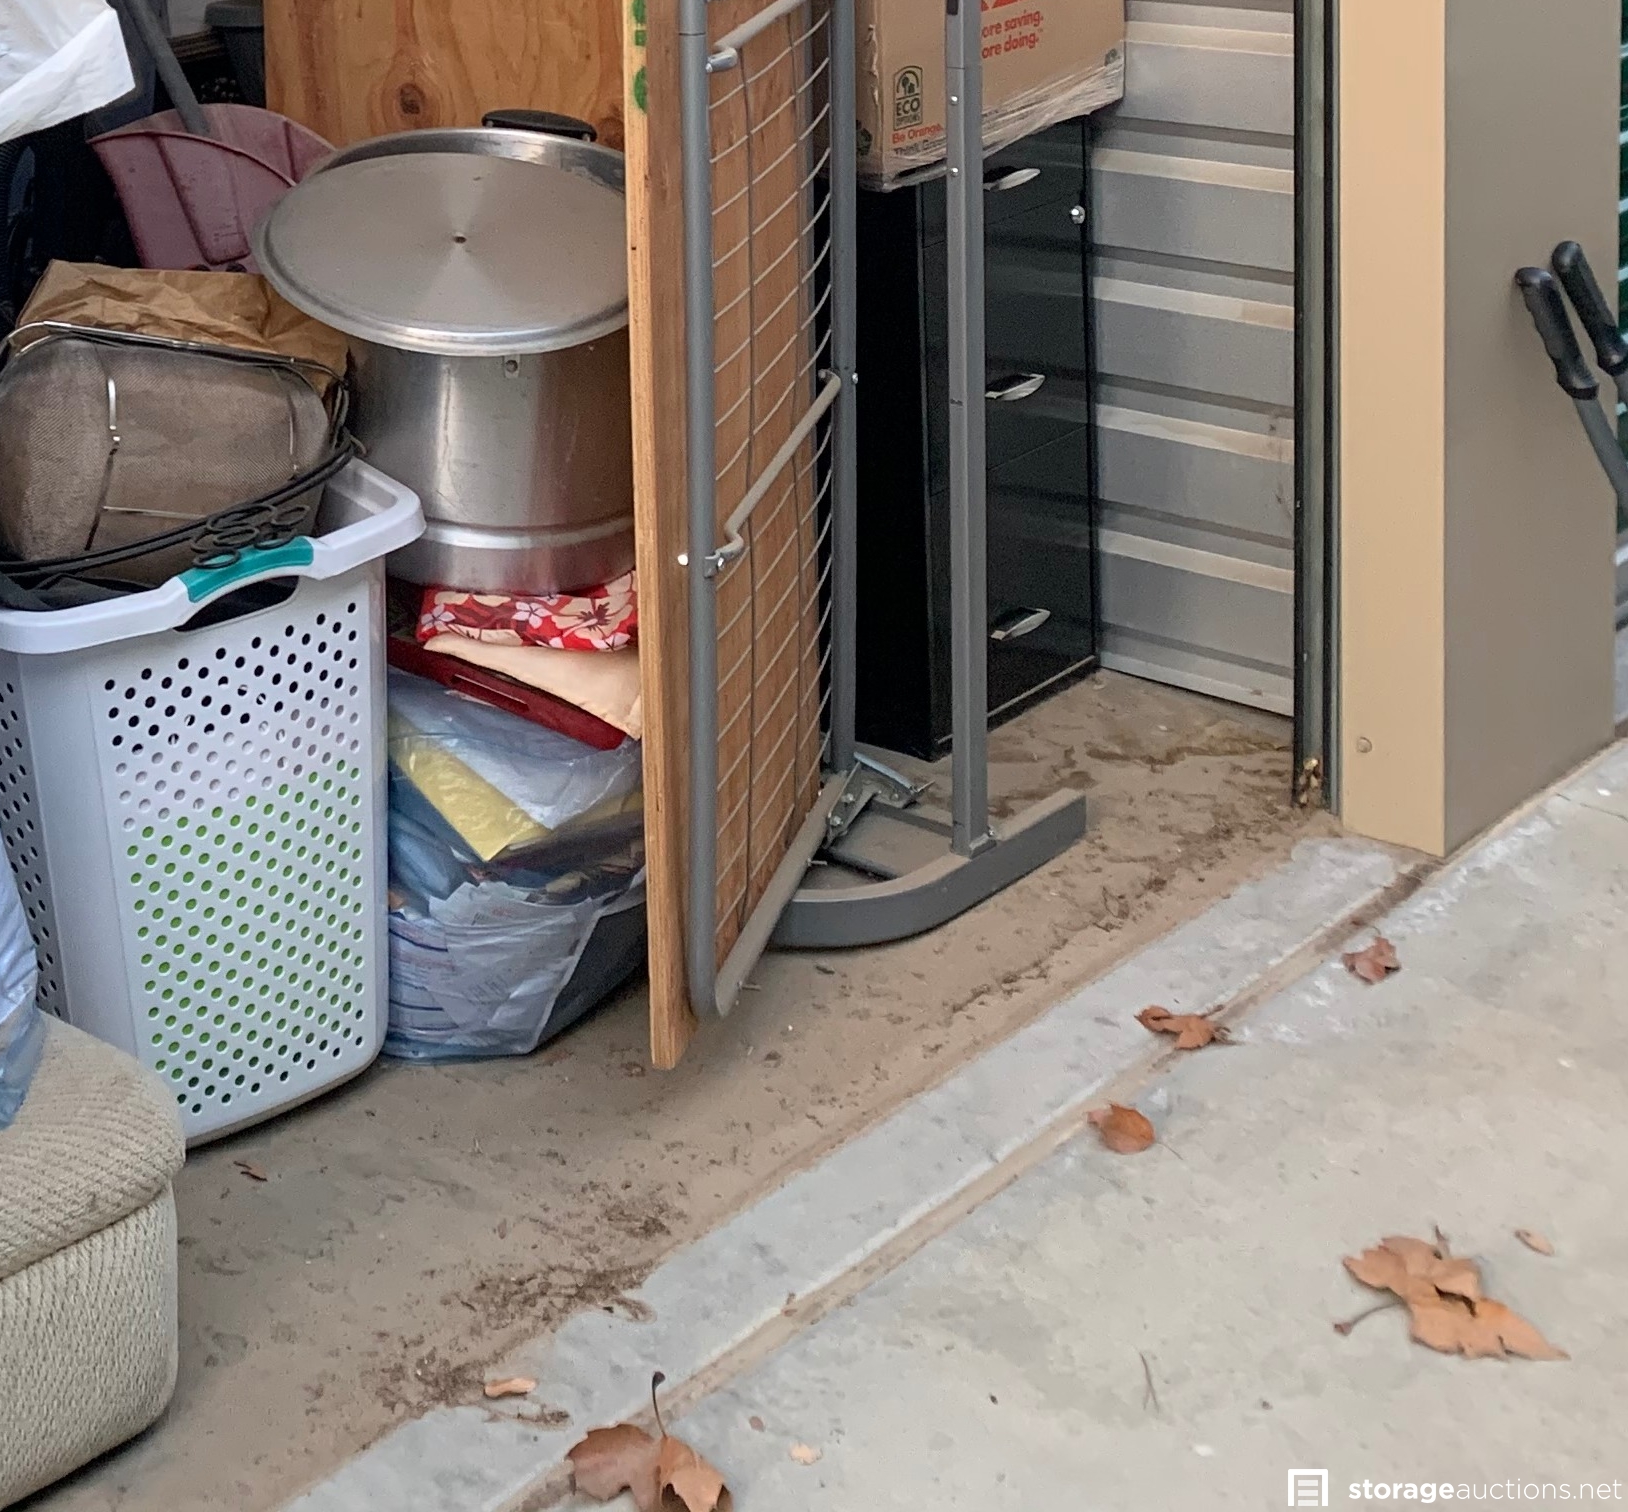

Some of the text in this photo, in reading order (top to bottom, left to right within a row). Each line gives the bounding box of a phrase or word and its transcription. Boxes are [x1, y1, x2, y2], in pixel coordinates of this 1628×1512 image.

[982, 9, 1044, 38] ore saving.
[982, 40, 1002, 59] ore
[896, 98, 921, 117] ECO
[892, 133, 906, 144] Be
